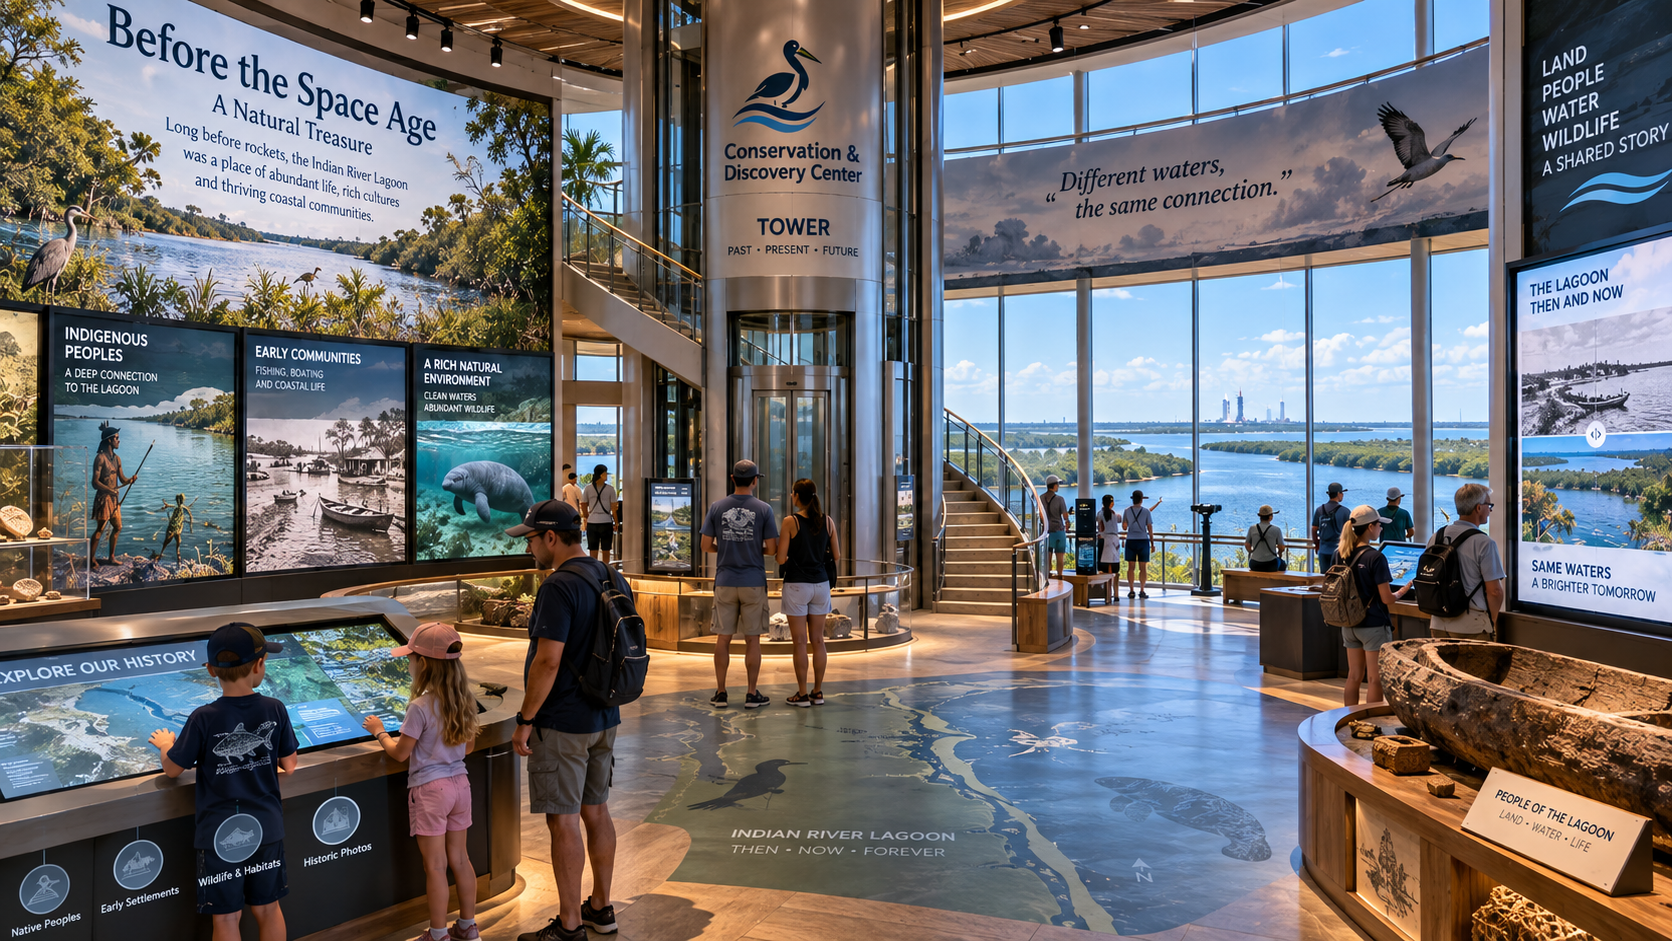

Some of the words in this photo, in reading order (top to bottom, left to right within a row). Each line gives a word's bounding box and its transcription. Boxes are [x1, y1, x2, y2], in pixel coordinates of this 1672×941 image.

[1543, 46, 1586, 77] LAND
[107, 4, 228, 80] Before
[238, 54, 288, 98] the
[298, 72, 378, 125] Space
[386, 101, 436, 146] Age
[1543, 63, 1604, 102] PEOPLE
[1542, 92, 1599, 126] WATER
[212, 94, 227, 116] A
[234, 99, 300, 136] Natural
[305, 120, 372, 155] Treasure
[1542, 110, 1619, 151] WILDLIFE
[166, 117, 198, 142] Long
[203, 126, 241, 149] before
[245, 142, 288, 164] rockets,
[292, 152, 309, 167] the
[312, 156, 344, 176] Indian
[347, 165, 371, 182] River
[374, 172, 408, 190] Lagoon
[724, 142, 841, 160] Conservation
[847, 145, 860, 162] &
[1542, 160, 1552, 176] A
[1557, 142, 1614, 172] SHARED
[1620, 123, 1669, 153] STORY
[184, 150, 207, 164] was
[211, 157, 217, 166] a
[222, 156, 251, 174] place
[255, 165, 266, 178] of
[269, 168, 319, 190] abundant
[322, 179, 339, 197] life,
[343, 185, 360, 199] rich
[363, 191, 399, 207] cultures
[725, 164, 806, 184] Discovery
[811, 164, 862, 182] Center
[1060, 166, 1146, 196] Different
[1153, 160, 1224, 181] waters,
[195, 176, 217, 190] and
[222, 178, 266, 204] thriving
[270, 193, 305, 208] coastal
[309, 202, 374, 222] communities.
[1076, 198, 1104, 218] the
[1109, 197, 1157, 215] same
[757, 218, 830, 236] TOWER
[728, 246, 752, 256] PAST
[766, 245, 809, 254] PRESENT
[823, 246, 858, 257] FUTURE
[1530, 280, 1552, 296] THE
[1556, 268, 1608, 291] LAGOON
[1530, 297, 1560, 314] THEN
[1563, 292, 1589, 308] AND
[1593, 284, 1623, 302] NOW
[66, 327, 148, 346] INDIGENOUS
[66, 345, 122, 362] PEOPLES
[256, 346, 288, 359] EARLY
[291, 348, 361, 364] COMMUNITIES
[65, 368, 72, 377] A
[75, 368, 98, 378] DEEP
[100, 370, 157, 382] CONNECTION
[256, 366, 288, 377] FISHING,
[290, 368, 324, 378] BOATING
[424, 358, 431, 368] A
[434, 359, 456, 370] RICH
[460, 361, 502, 373] NATURAL
[65, 382, 78, 392] TO
[80, 383, 98, 393] THE
[101, 384, 139, 394] LAGOON
[256, 380, 272, 388] AND
[275, 380, 309, 390] COASTAL
[311, 382, 325, 391] LIFE
[424, 373, 491, 386] ENVIRONMENT
[424, 391, 447, 400] CLEAN
[449, 393, 476, 401] WATERS
[424, 404, 462, 412] ABUNDANT
[464, 405, 495, 413] WILDLIFE
[1532, 560, 1562, 574] SAME
[1565, 563, 1611, 579] WATERS
[1532, 578, 1538, 588] A
[1542, 578, 1588, 594] BRIGHTER
[1592, 584, 1656, 602] TOMORROW
[0, 664, 76, 684] XPLORE
[80, 660, 120, 674] OUR
[124, 650, 196, 668] HISTORY
[1495, 790, 1531, 810] PEOPLE
[1532, 803, 1546, 814] OF
[1547, 808, 1567, 824] THE
[1568, 816, 1614, 842] LAGOON
[731, 829, 800, 838] INDIAN
[807, 830, 862, 839] RIVER
[870, 831, 955, 841] LAGOON
[1499, 810, 1523, 825] LAND
[1532, 822, 1562, 841] WATER
[1570, 837, 1592, 852] LIFE
[304, 852, 338, 867] Historic
[341, 844, 372, 857] Photos
[732, 845, 778, 854] THEN
[798, 846, 844, 854] NOW
[864, 847, 945, 857] FOREVER
[198, 871, 232, 886] Wildlife
[235, 868, 242, 877] &
[244, 860, 281, 875] Habitats
[1136, 872, 1153, 882] N
[101, 900, 124, 913] Early
[126, 888, 179, 907] Settlements
[12, 924, 42, 937] Native
[45, 913, 81, 928] Peoples
